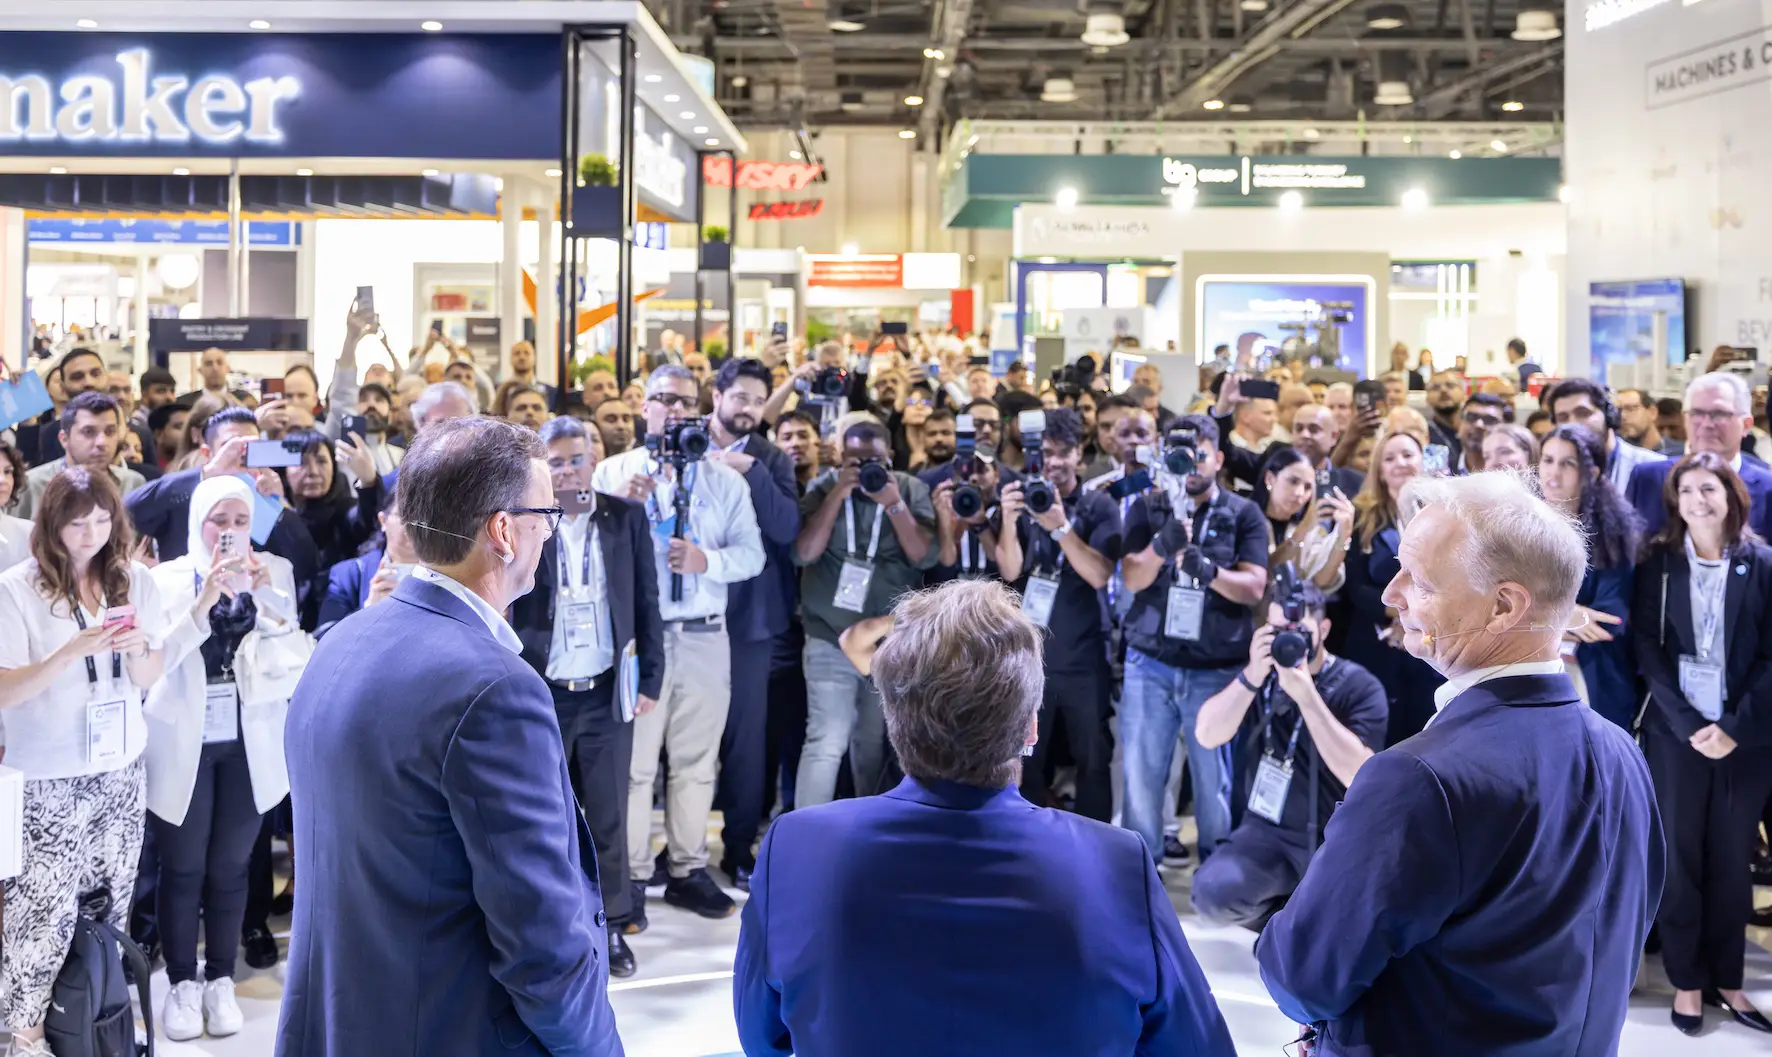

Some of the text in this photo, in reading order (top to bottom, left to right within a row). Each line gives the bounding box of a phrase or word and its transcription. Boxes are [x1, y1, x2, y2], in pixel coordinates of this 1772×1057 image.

[1655, 50, 1737, 94] MACHINES
[1742, 46, 1754, 70] &
[1759, 277, 1772, 302] F
